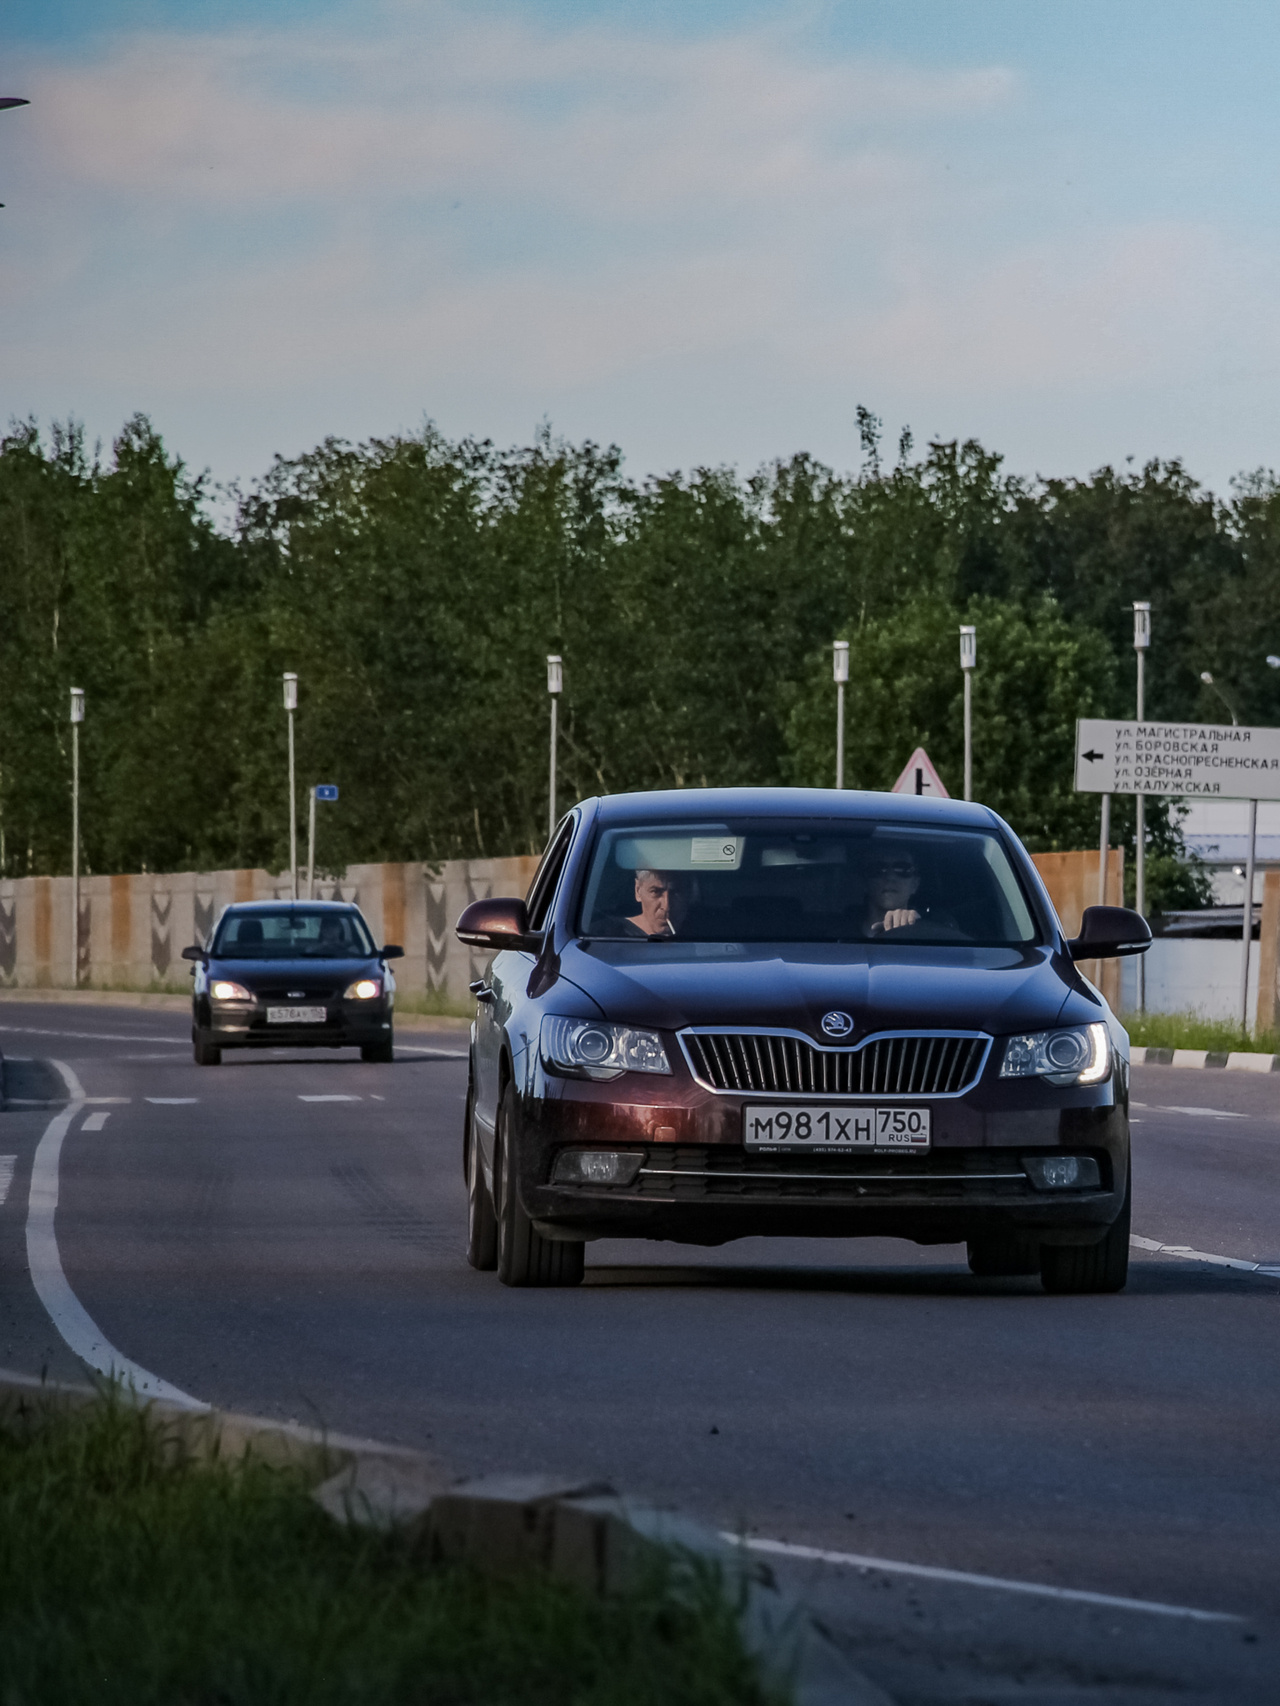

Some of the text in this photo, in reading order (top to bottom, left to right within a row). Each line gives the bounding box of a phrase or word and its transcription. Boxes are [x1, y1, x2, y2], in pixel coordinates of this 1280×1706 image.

[1135, 727, 1251, 742] МАГИСТРАЛЬНАЯ
[1135, 740, 1219, 753] БОРОВСКАЯ
[1135, 753, 1279, 769] КРАСНОПРЕСНЕНСКАЯ
[1134, 765, 1192, 778] ОЗЁРНАЯ
[1133, 780, 1220, 793] КАЛУЖСКАЯ
[878, 1111, 922, 1133] 750
[888, 1133, 910, 1143] RUS
